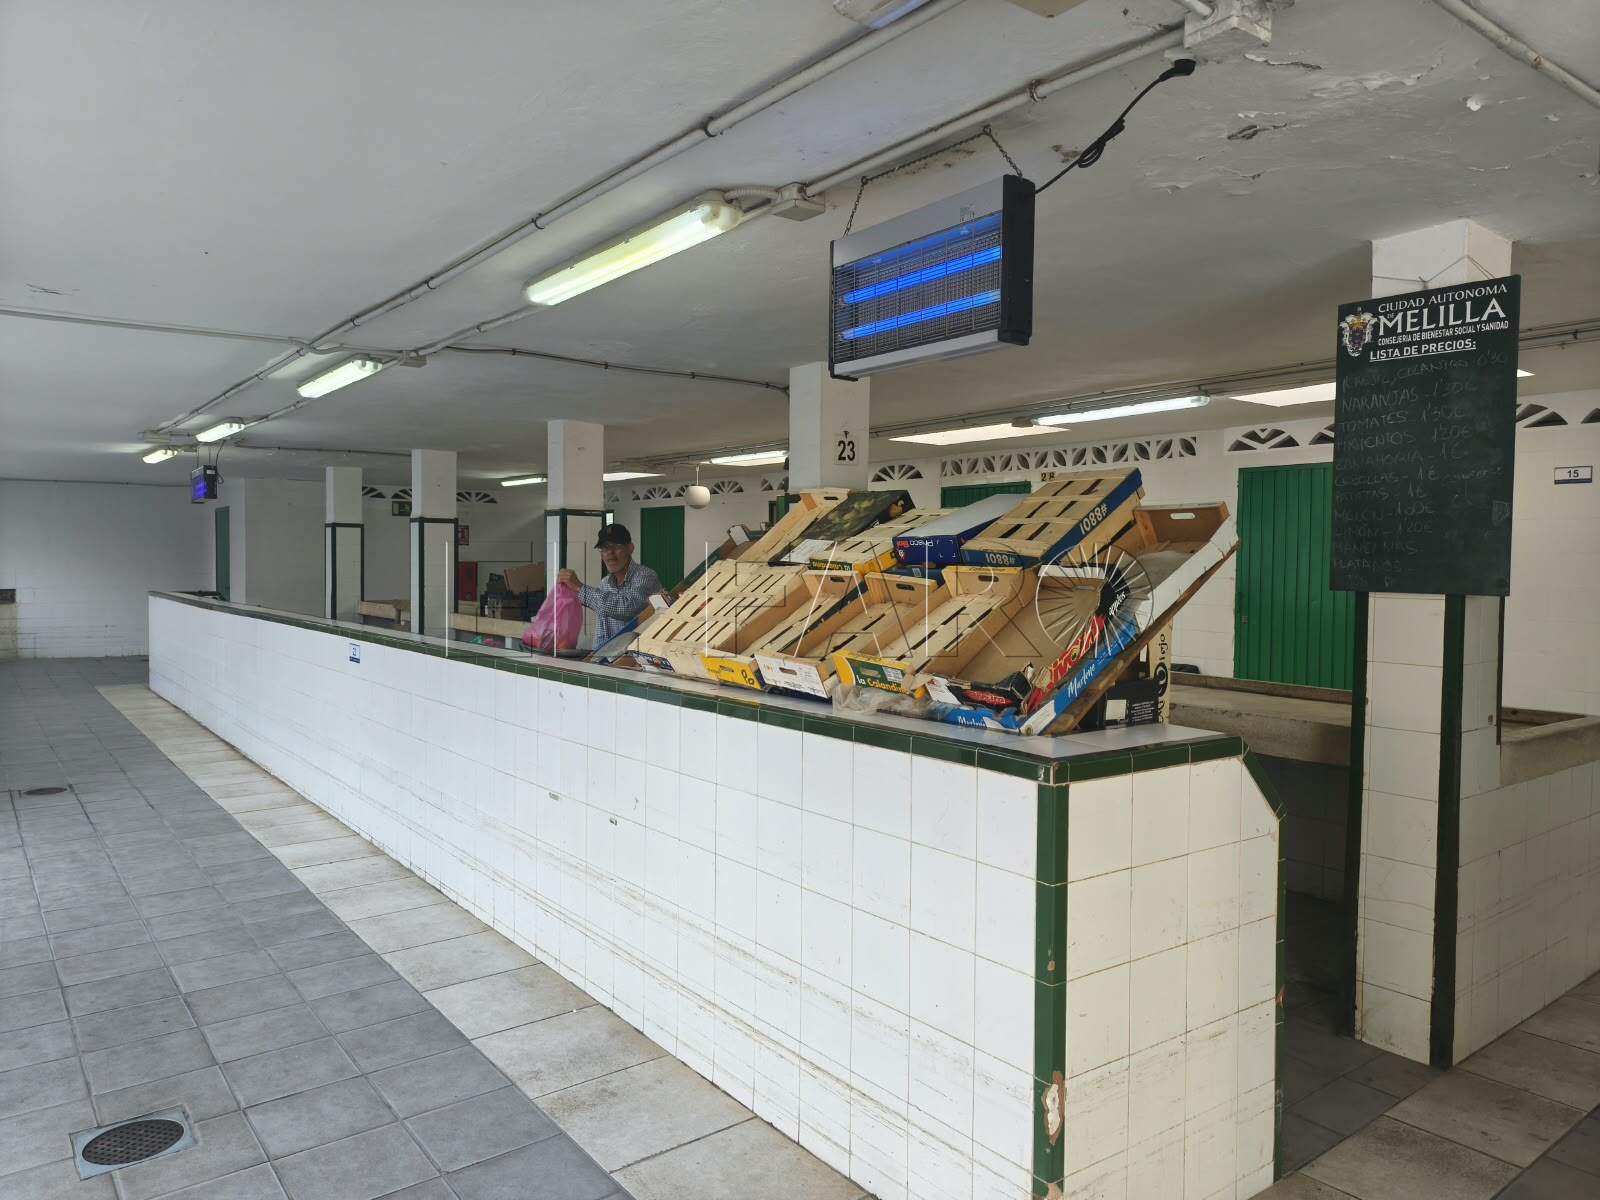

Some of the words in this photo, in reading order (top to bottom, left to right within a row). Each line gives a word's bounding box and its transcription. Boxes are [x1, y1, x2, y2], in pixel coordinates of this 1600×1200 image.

[1378, 297, 1425, 313] CIUDAD
[1428, 283, 1508, 305] AUTONOMA
[1378, 297, 1507, 336] MELILLA
[1378, 335, 1412, 346] CONSEJERIA
[1412, 333, 1421, 342] DE
[1421, 328, 1454, 341] BIENESTAR
[1454, 325, 1476, 335] SOCIAL
[1481, 320, 1509, 331] SANIDAD
[1370, 347, 1401, 361] LISTA
[1403, 344, 1419, 356] DE
[1421, 338, 1477, 354] PRECIOS:
[838, 440, 855, 461] 23
[1567, 469, 1580, 478] 15
[856, 675, 866, 685] la
